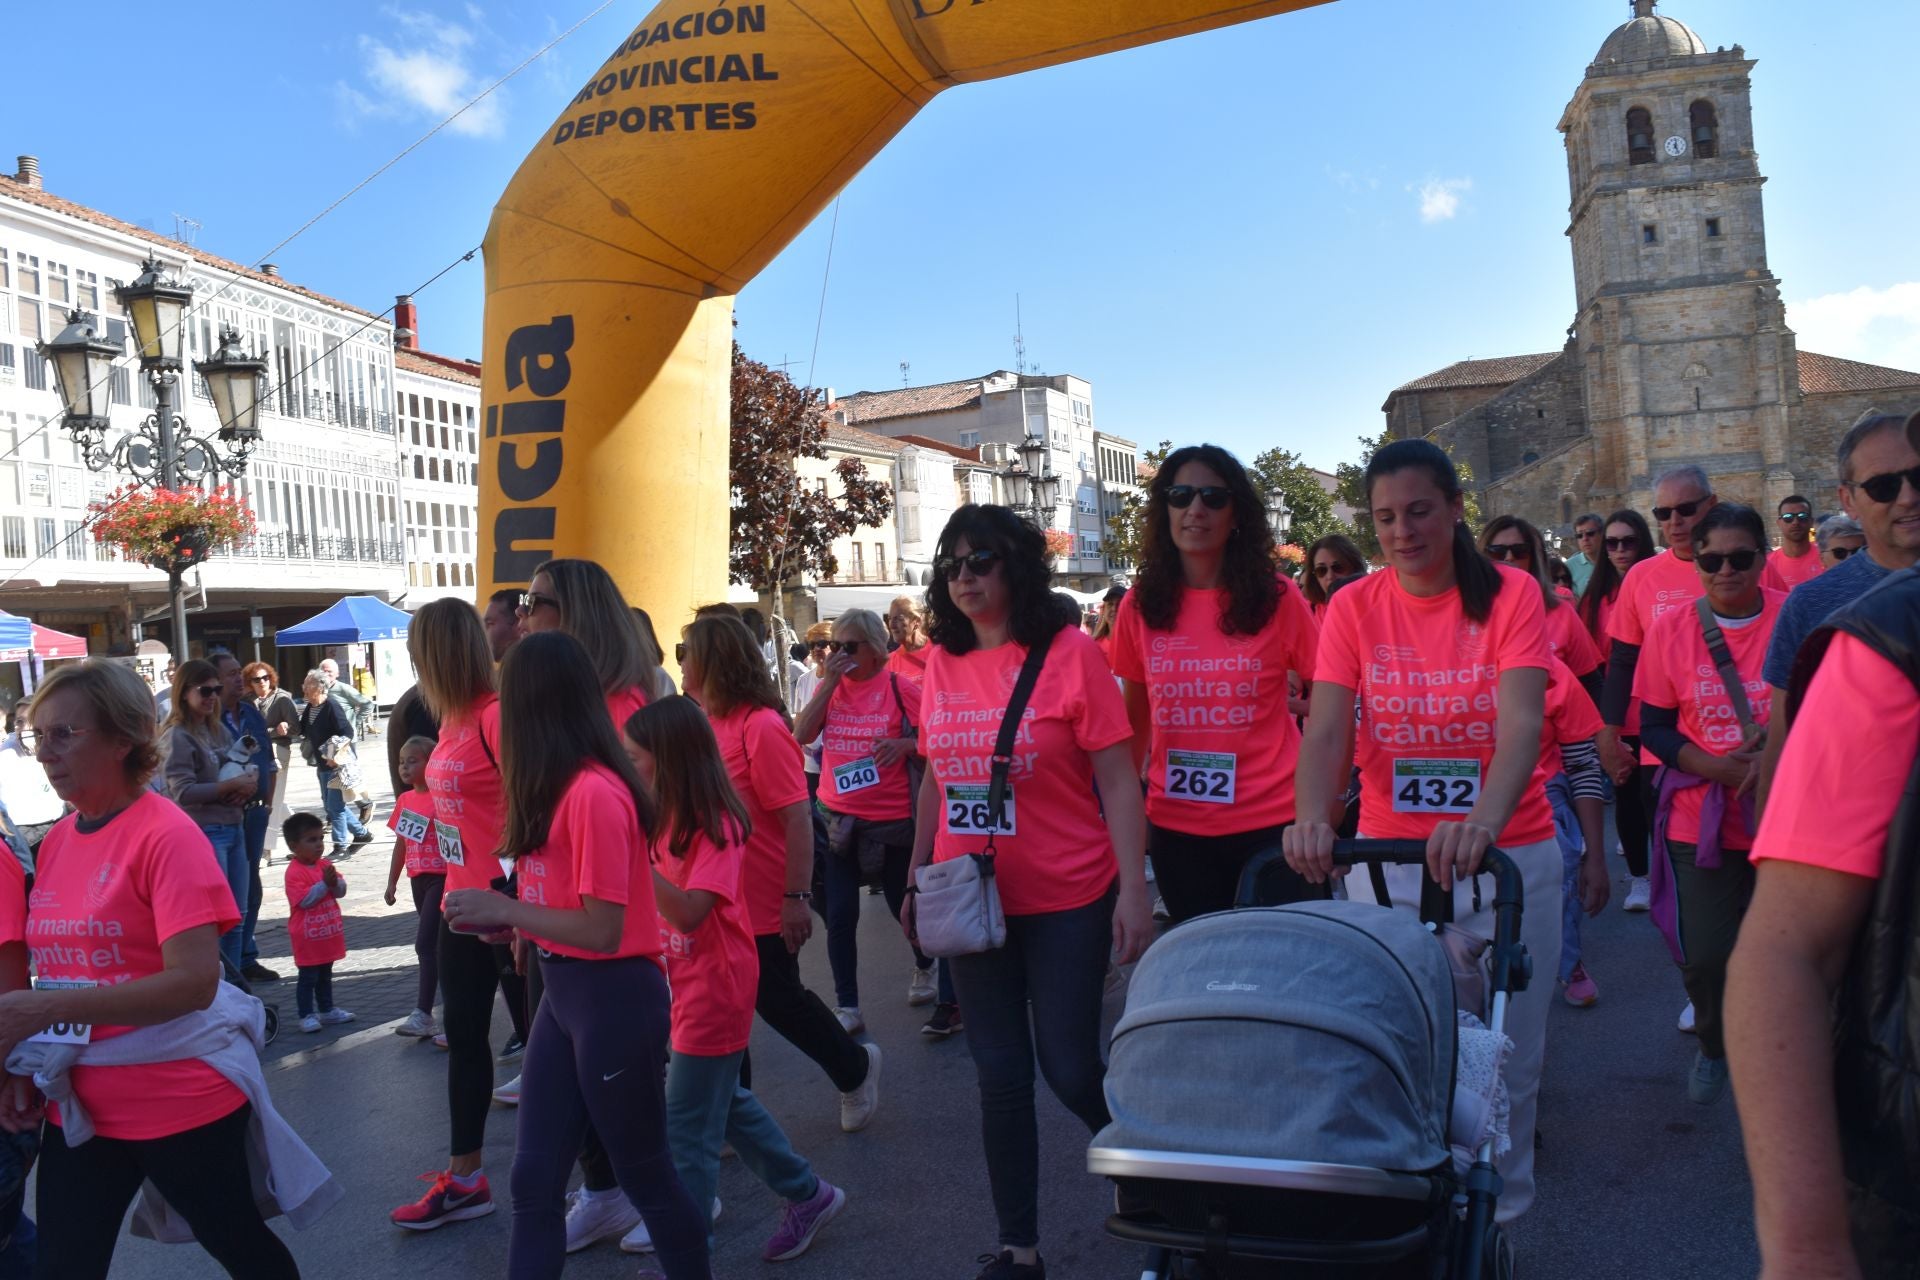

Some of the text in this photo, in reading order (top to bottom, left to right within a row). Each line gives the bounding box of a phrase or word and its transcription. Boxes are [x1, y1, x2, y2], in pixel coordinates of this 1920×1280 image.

[553, 102, 757, 145] DEPORTES
[486, 315, 574, 588] ncia
[1151, 654, 1262, 673] En marcha
[1372, 663, 1496, 686] En marcha
[1152, 676, 1258, 698] contra el
[1701, 681, 1726, 697] En
[1373, 693, 1469, 715] contra
[1473, 686, 1497, 711] el
[845, 713, 889, 724] marcha
[932, 709, 953, 726] En
[1156, 700, 1256, 726] cáncer
[825, 723, 888, 736] contra el
[838, 768, 875, 790] 040
[1169, 768, 1229, 797] 262
[1398, 778, 1474, 807] 432
[398, 819, 424, 840] 312
[524, 881, 547, 905] el
[38, 914, 123, 937] marcha
[31, 942, 126, 967] ontra el
